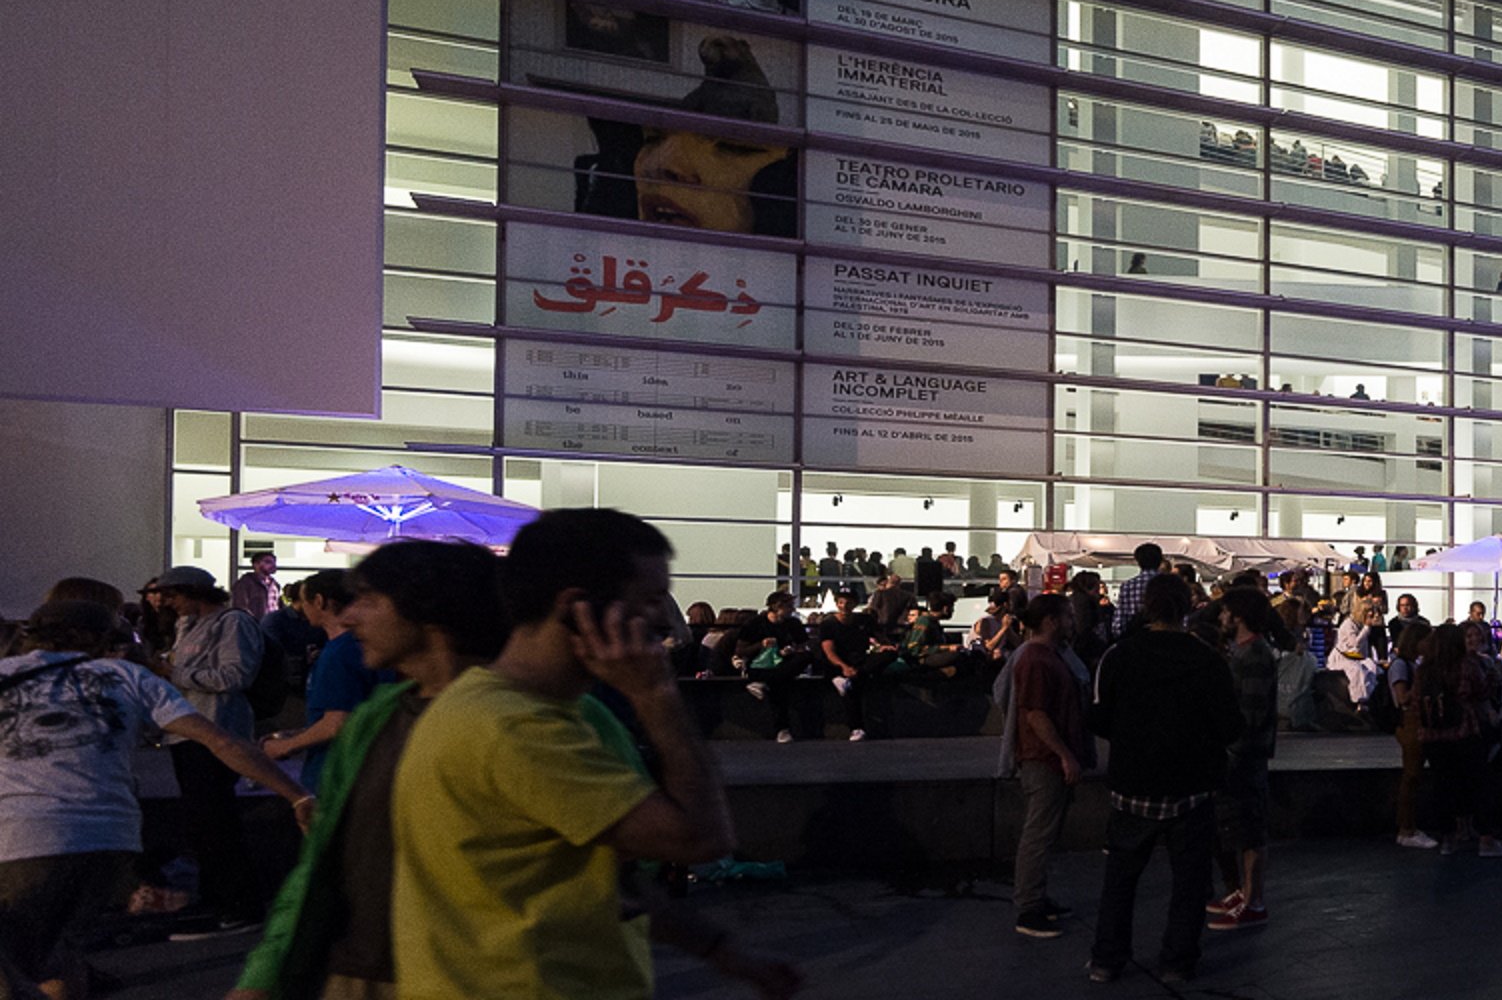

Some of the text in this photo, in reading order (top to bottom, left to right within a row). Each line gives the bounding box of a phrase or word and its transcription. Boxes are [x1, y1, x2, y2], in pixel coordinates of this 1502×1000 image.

[838, 5, 856, 15] DEL
[876, 12, 888, 21] DE
[892, 15, 922, 29] MARÇ
[838, 14, 851, 23] AL
[870, 20, 916, 36] D'AGOST
[920, 29, 933, 39] DE
[936, 33, 959, 44] 2015
[838, 54, 943, 82] L'HERÈNCIA
[837, 68, 948, 97] IMMATERIAL
[837, 89, 893, 104] ASSAJANT
[920, 102, 933, 111] DE
[936, 105, 949, 115] LA
[835, 110, 861, 121] FINS
[864, 114, 878, 124] AL
[896, 119, 909, 128] DE
[912, 122, 940, 133] MAIG
[942, 126, 955, 136] DE
[958, 129, 981, 140] 2015
[836, 159, 1025, 197] TEATRO PROLETARIO
[837, 172, 860, 187] DE
[836, 193, 982, 220] OSVALDO LAMBORGHINI
[835, 215, 855, 225] DEL
[874, 219, 888, 229] DE
[891, 222, 928, 233] GENER
[835, 225, 851, 233] AL
[859, 226, 872, 236] DE
[876, 230, 904, 239] JUNY
[907, 233, 921, 242] DE
[923, 235, 947, 245] 2015
[834, 264, 993, 293] PASSAT INQUIET
[834, 286, 890, 298] NARRATIVES
[899, 292, 953, 304] FANTASMES
[834, 294, 1029, 320] INTERNACIONAL D'ART EN SOLIDARITAT AMB
[834, 321, 854, 330] DEL
[872, 324, 887, 333] DE
[890, 326, 931, 337] FEBRER
[834, 330, 848, 339] AL
[858, 332, 870, 341] DE
[874, 334, 903, 344] JUNY
[905, 336, 919, 346] DE
[922, 338, 945, 347] 2015
[563, 370, 589, 380] this
[832, 370, 987, 393] ART & LANGUAGE
[832, 382, 939, 401] INCOMPLET
[637, 409, 673, 421] based
[725, 416, 741, 425] on
[896, 409, 940, 419] PHILIPPE
[833, 427, 859, 437] FINS
[861, 428, 875, 437] AL
[891, 430, 932, 441] D'ABRIL
[934, 432, 948, 442] DE
[951, 433, 974, 444] 2015
[563, 439, 583, 450] the
[631, 443, 679, 455] context
